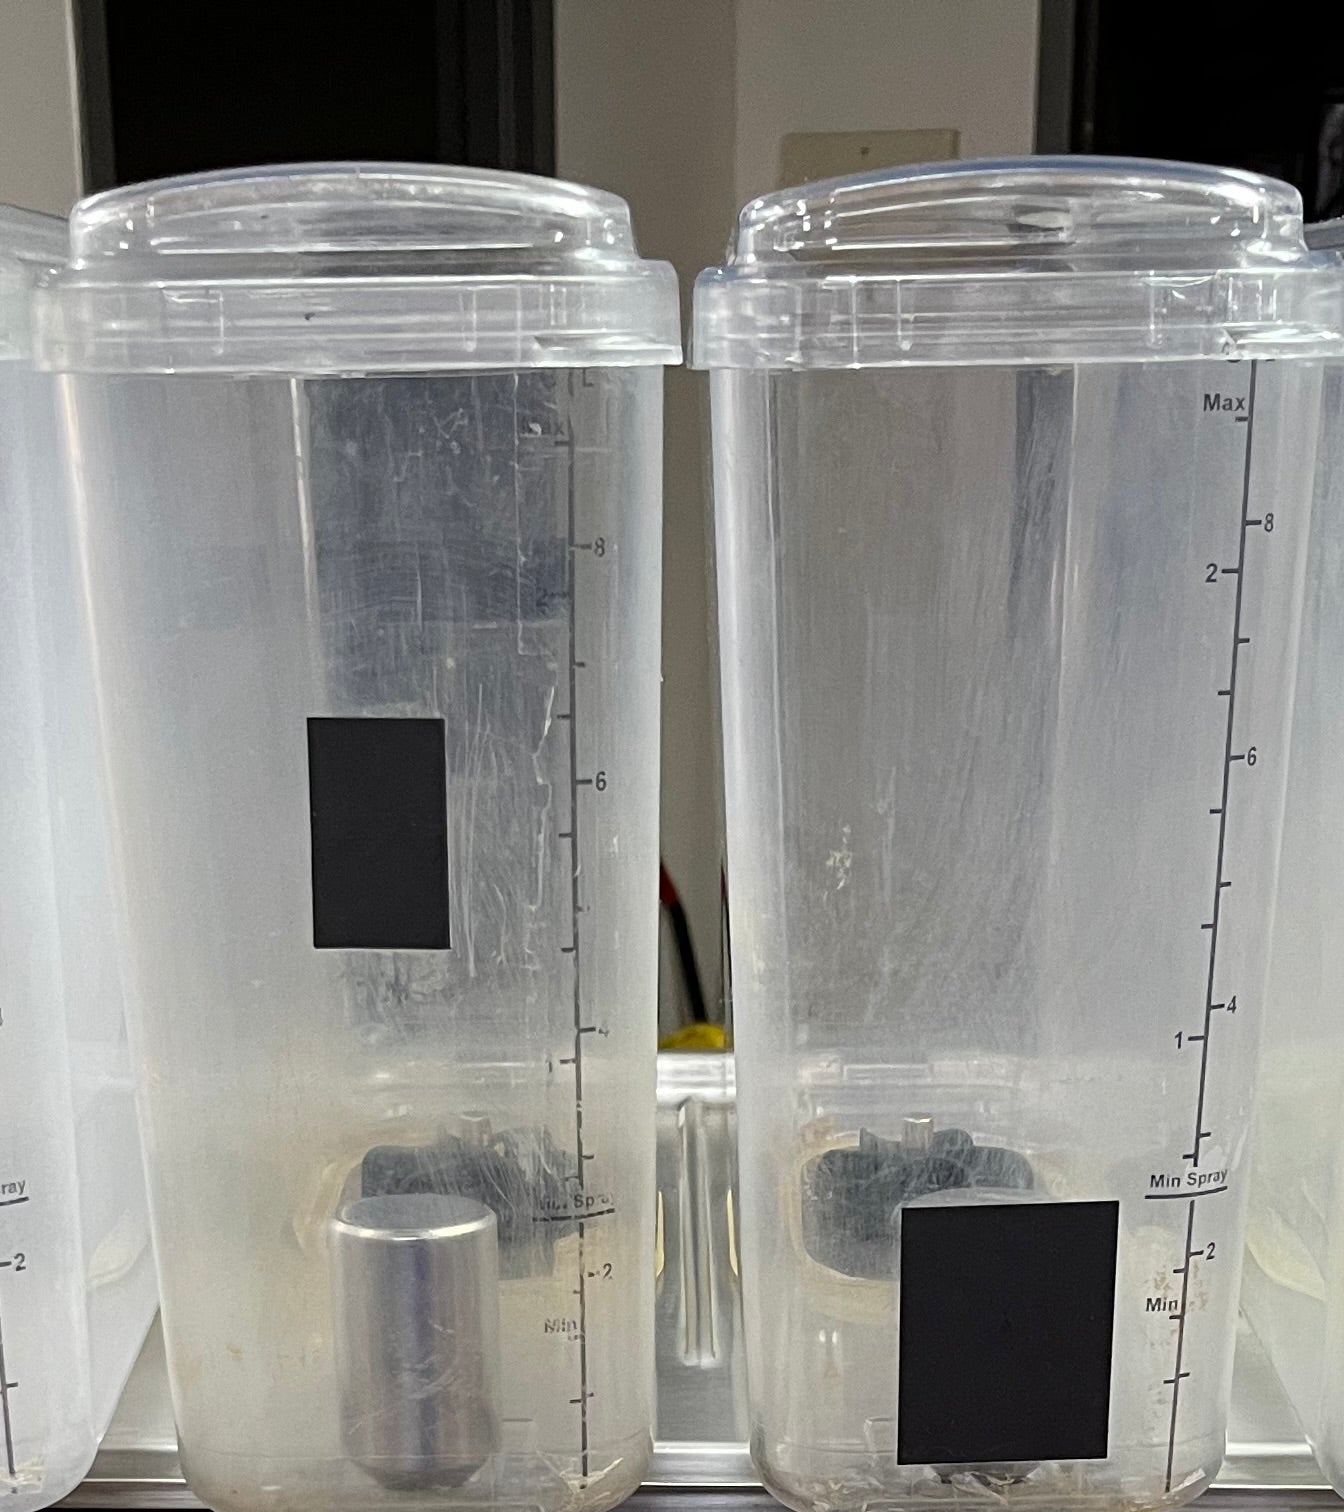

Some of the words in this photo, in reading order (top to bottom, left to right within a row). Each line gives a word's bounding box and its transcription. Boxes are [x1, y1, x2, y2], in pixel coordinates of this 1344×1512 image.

[1203, 393, 1246, 412] Max
[1264, 513, 1275, 532] 8
[594, 537, 605, 557] 8
[1205, 563, 1218, 583] 2
[1247, 746, 1257, 766] 6
[595, 772, 607, 791] 6
[1226, 996, 1237, 1014] 4
[1174, 1032, 1183, 1049] 1
[1150, 1173, 1181, 1188] Min
[1187, 1167, 1228, 1190] Spray
[1206, 1242, 1216, 1261] 2
[13, 1253, 26, 1271] 2
[602, 1263, 613, 1280] 2
[1146, 1297, 1179, 1312] Min
